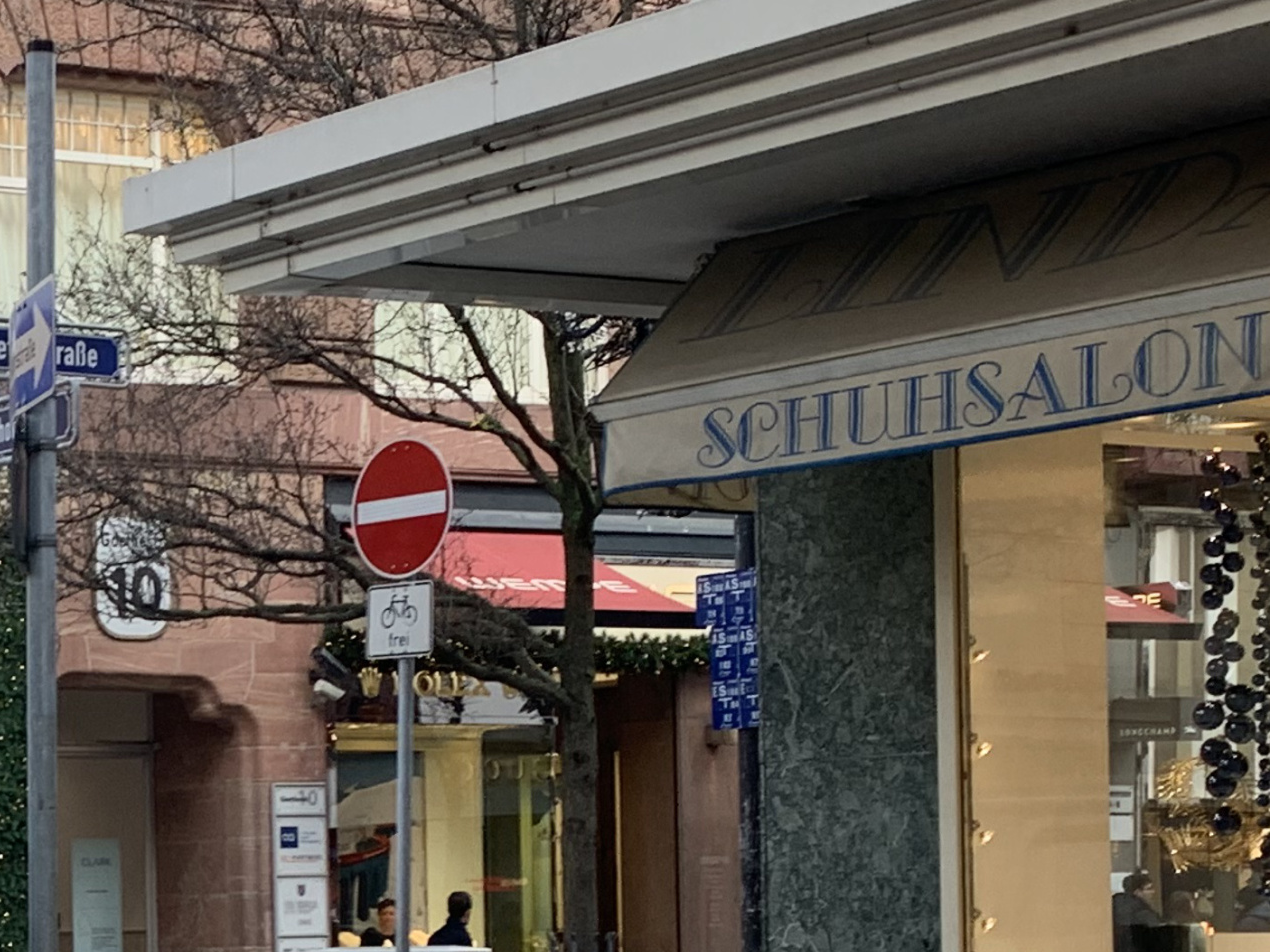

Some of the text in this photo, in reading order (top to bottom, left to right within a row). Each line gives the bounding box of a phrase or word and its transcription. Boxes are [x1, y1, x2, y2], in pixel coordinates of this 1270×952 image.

[696, 311, 1270, 468] SCHUHSALON
[454, 575, 637, 594] WEME
[387, 632, 410, 648] frei
